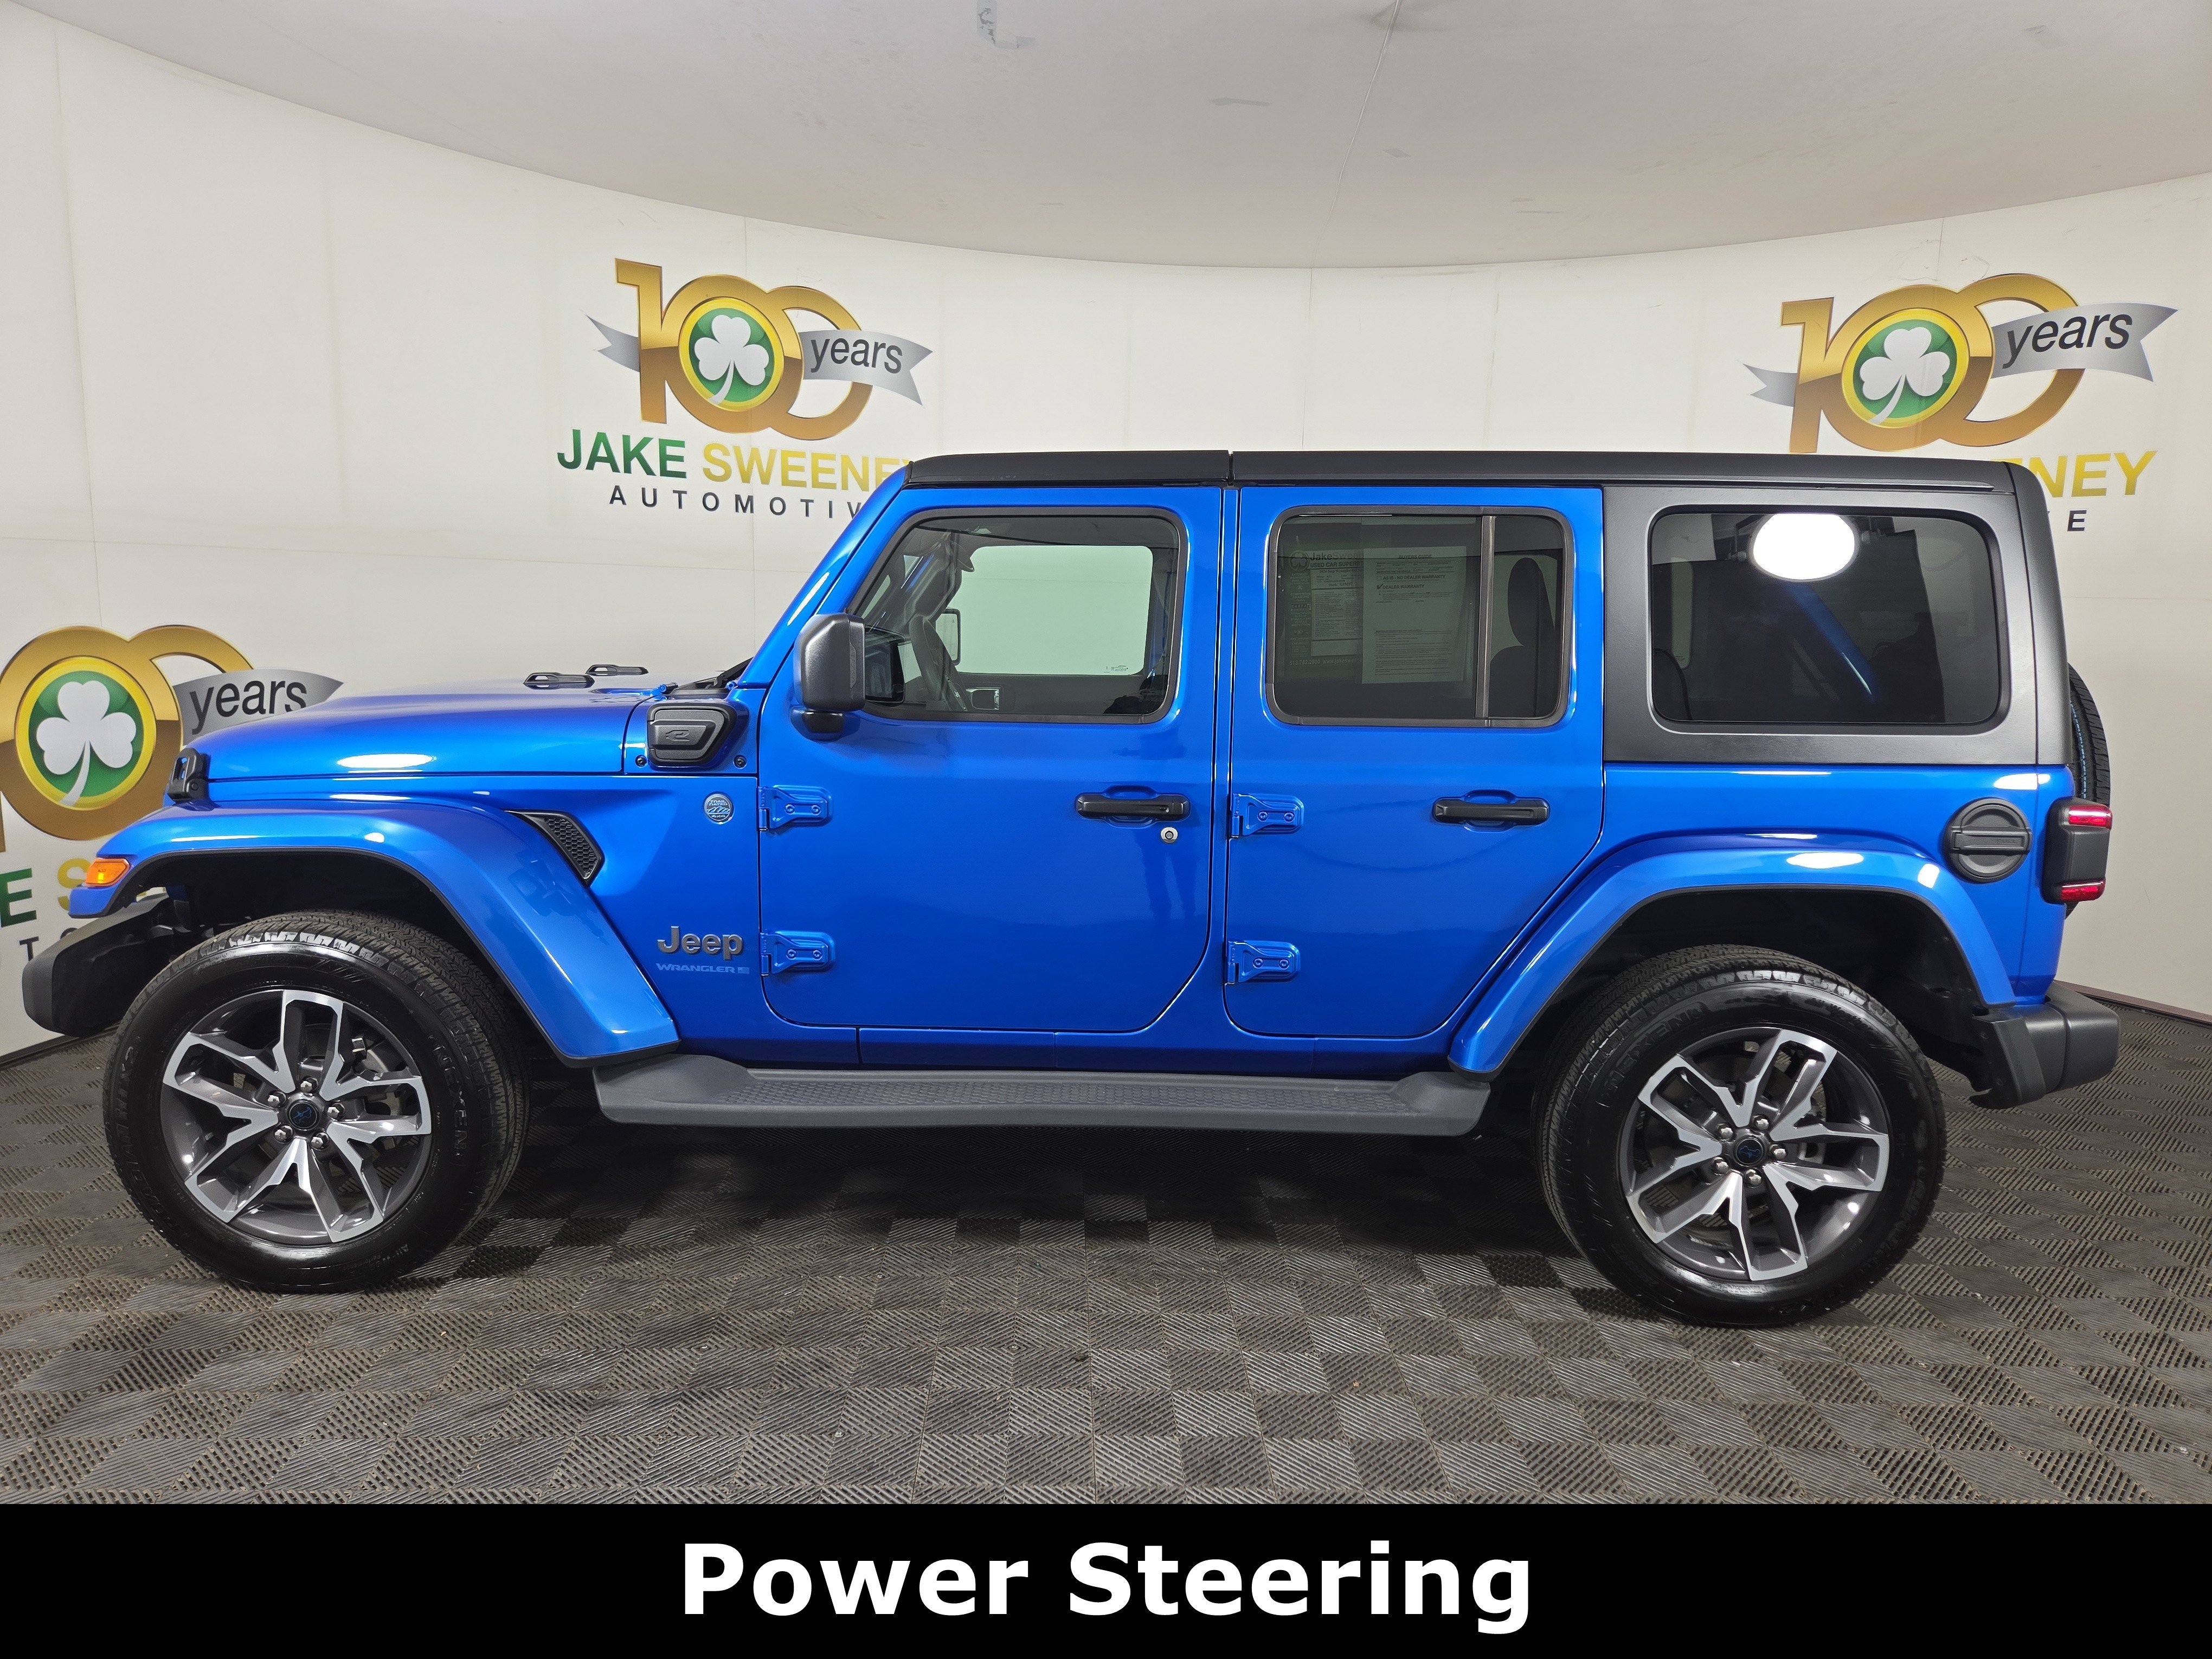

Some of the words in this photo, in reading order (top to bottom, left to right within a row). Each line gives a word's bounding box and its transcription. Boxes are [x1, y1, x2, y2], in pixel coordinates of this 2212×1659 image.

[810, 337, 903, 375] years
[2003, 314, 2133, 369] years
[557, 429, 687, 478] JAKE
[703, 443, 909, 492] SWEENE
[609, 485, 861, 519] AUTOMOTIV
[190, 679, 307, 735] years
[657, 925, 743, 960] Jeep
[655, 963, 736, 973] WRANGLER
